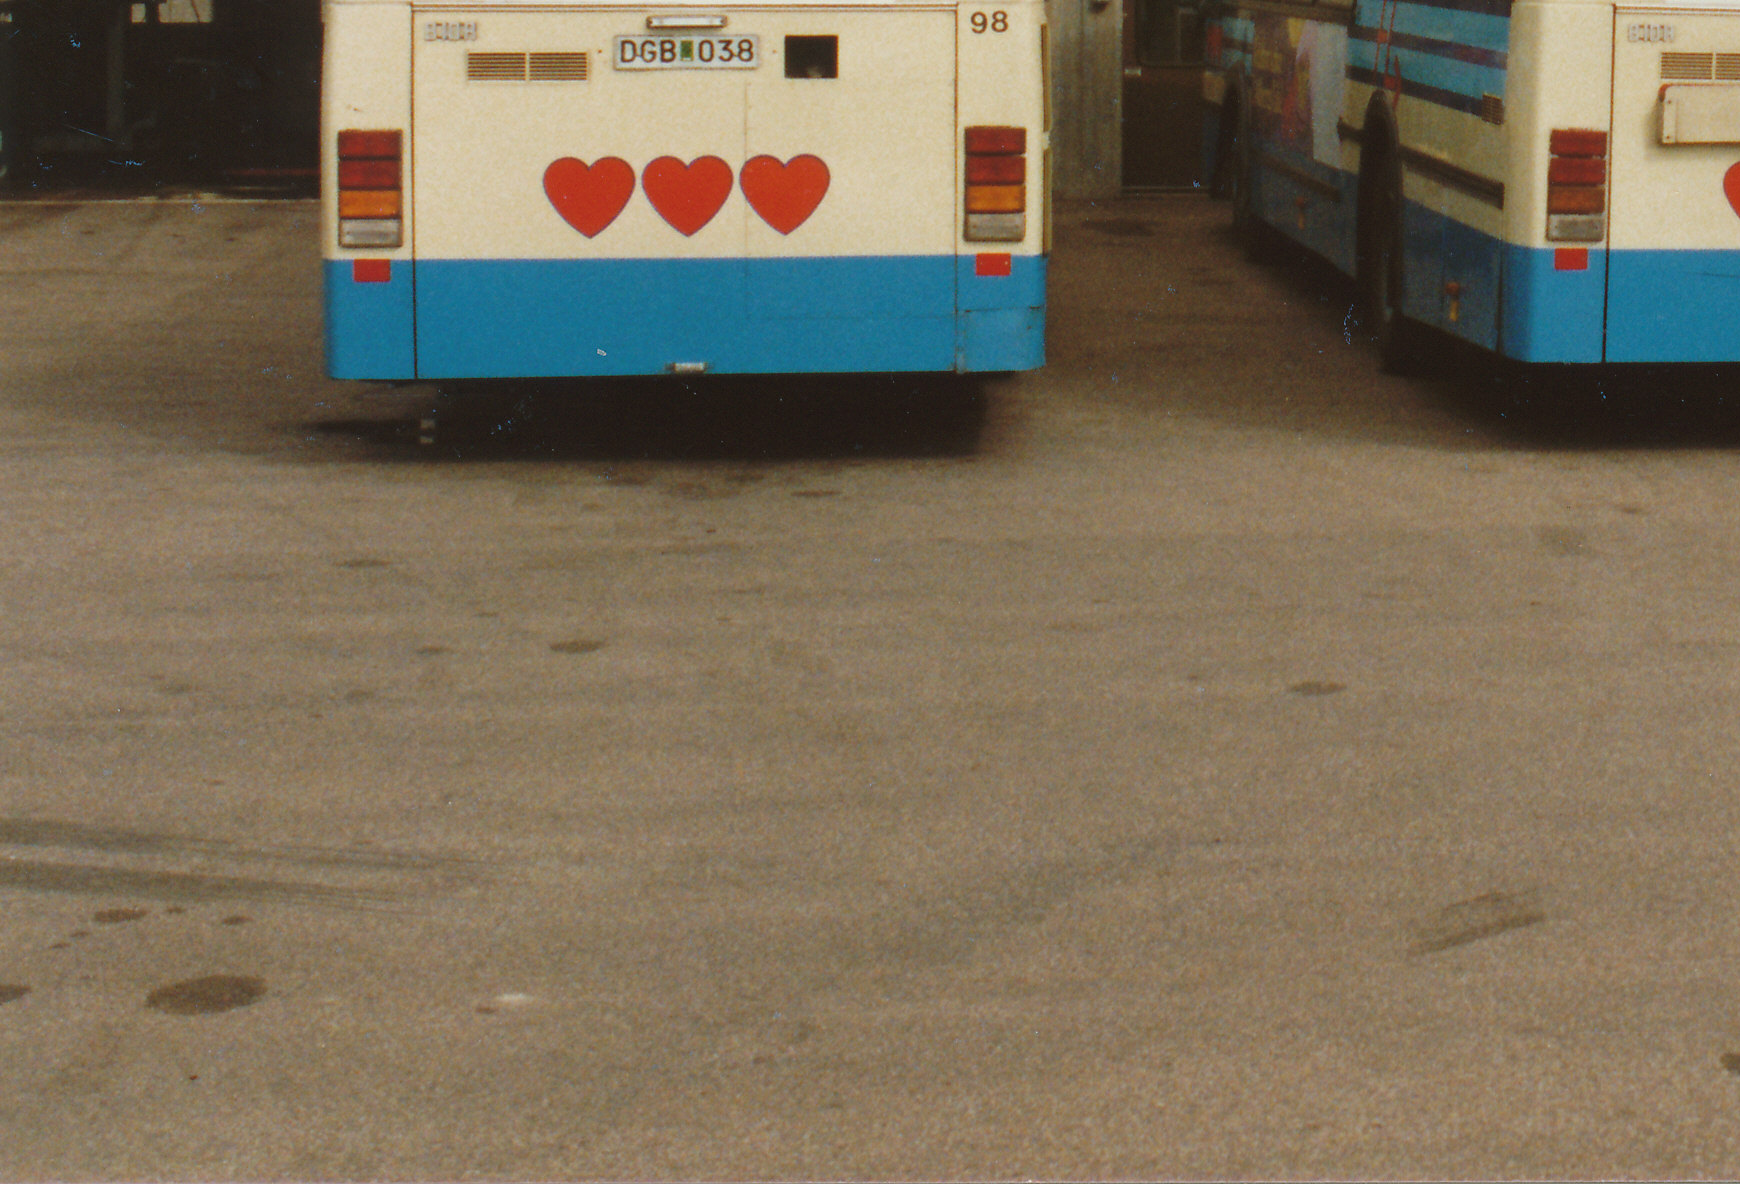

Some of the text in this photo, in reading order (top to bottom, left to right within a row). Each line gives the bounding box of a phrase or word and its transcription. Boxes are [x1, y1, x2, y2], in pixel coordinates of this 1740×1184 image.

[970, 10, 1009, 34] 98
[620, 38, 754, 63] DGB 038
